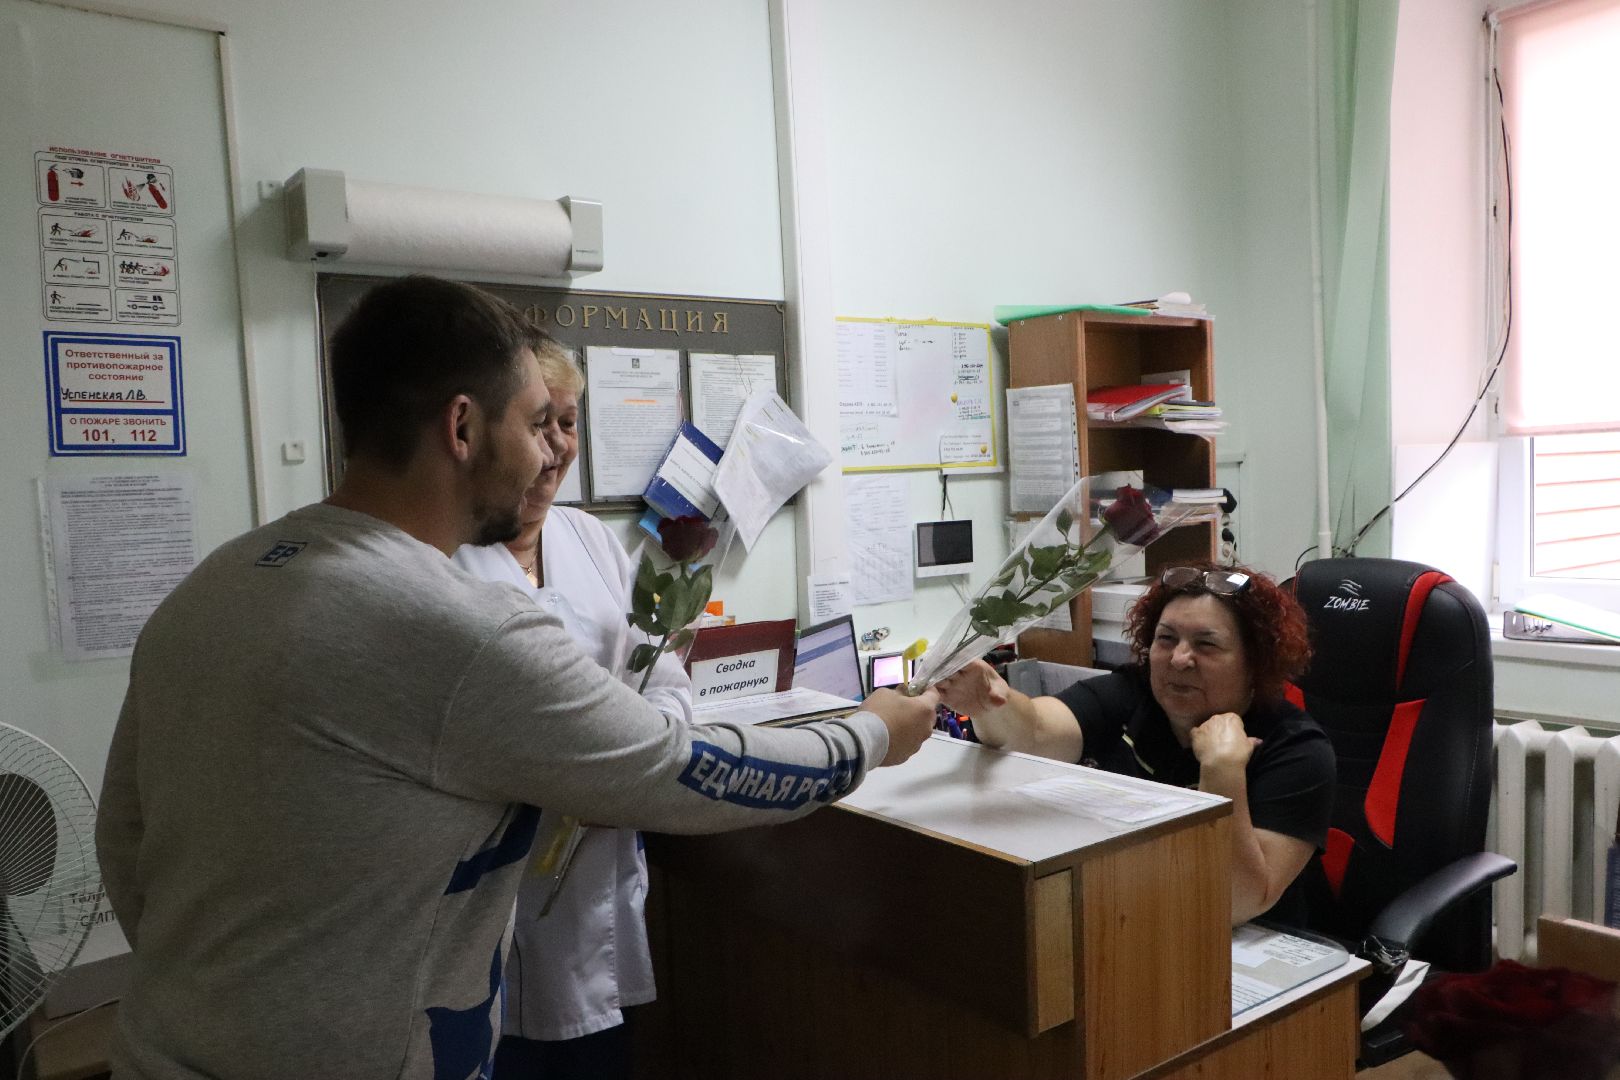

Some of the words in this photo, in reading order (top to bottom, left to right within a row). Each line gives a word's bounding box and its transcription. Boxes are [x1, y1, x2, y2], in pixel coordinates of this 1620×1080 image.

[65, 349, 149, 360] Ответственный
[152, 353, 164, 361] за
[66, 361, 163, 371] противопожарное
[88, 373, 144, 381] состояние
[69, 417, 77, 425] О
[80, 417, 121, 426] ПОЖАРЕ
[123, 418, 167, 426] ЗВОНИТЬ
[130, 429, 157, 442] 112
[1323, 596, 1371, 611] ZOMBIE
[716, 659, 756, 674] Сводка
[700, 688, 707, 697] в
[709, 676, 769, 695] пожарную
[691, 751, 796, 801] ЕДИНАЯ
